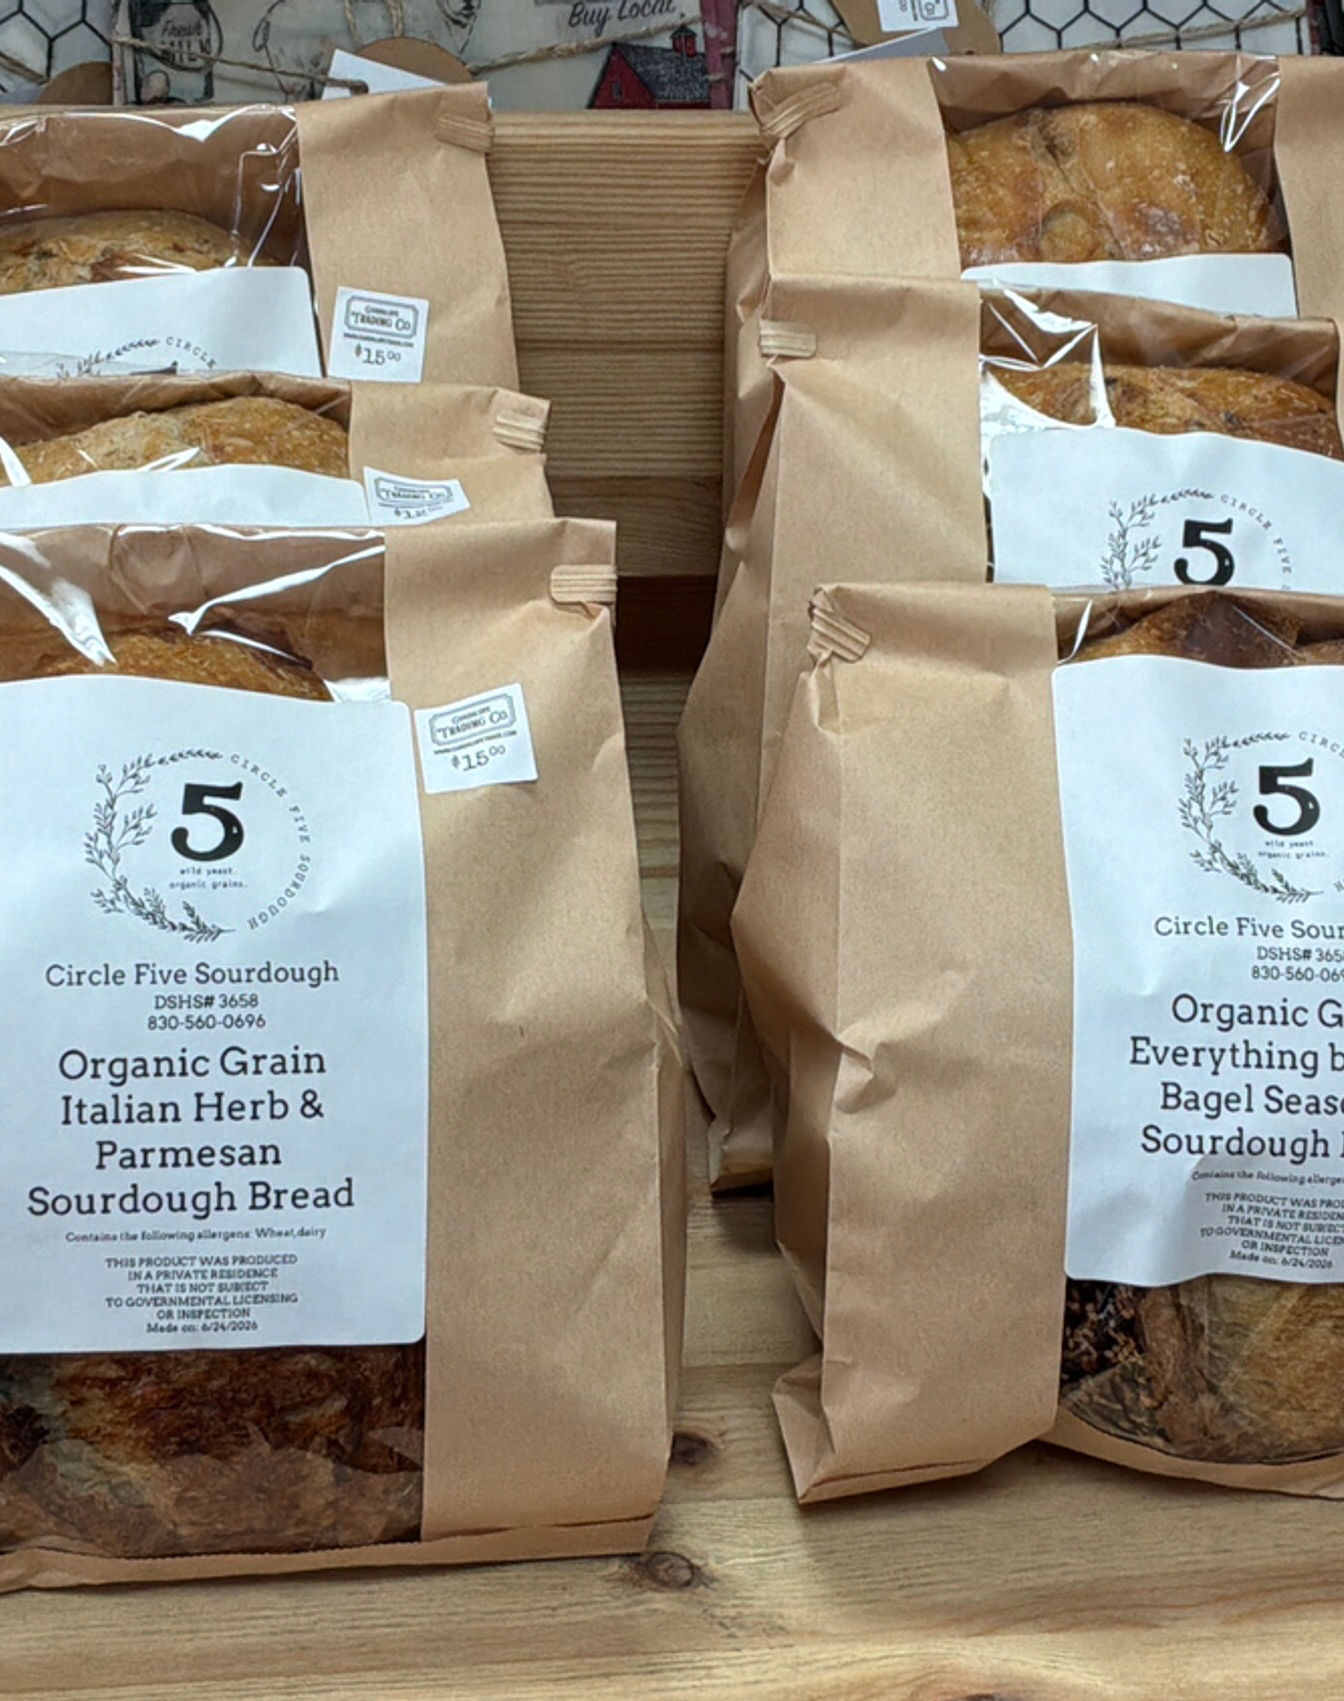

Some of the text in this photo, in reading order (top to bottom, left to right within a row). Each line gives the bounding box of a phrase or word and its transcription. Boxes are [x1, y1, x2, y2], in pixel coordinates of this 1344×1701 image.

[568, 2, 609, 38] Buy
[166, 336, 216, 369] CIRCLE
[1221, 494, 1291, 574] CIRCLE FIVE
[1174, 518, 1235, 586] 5
[1253, 757, 1321, 837] 5
[171, 781, 244, 862] 5
[230, 754, 311, 930] CIRCLE FIVE SOURDOUGH
[1155, 916, 1229, 936] Circle
[1236, 917, 1284, 939] Five
[1257, 947, 1311, 962] DSHS#
[45, 961, 339, 988] Circle Five Sourdough
[155, 994, 258, 1010] DSHS# 3658
[1172, 993, 1308, 1032] Organic
[148, 1014, 266, 1030] 830-560-0696
[59, 1045, 326, 1087] Organic Grain
[1130, 1036, 1319, 1078] Everything
[62, 1089, 324, 1125] Italian Herb &
[1161, 1082, 1254, 1119] Bagel
[96, 1141, 281, 1170] Parmesan
[1141, 1124, 1330, 1165] Sourdough
[28, 1177, 354, 1221] Sourdough Bread
[65, 1232, 117, 1242] Contains
[119, 1232, 138, 1241] the
[141, 1231, 195, 1242] following
[105, 1254, 298, 1268] THIS PRODUCT WAS PRODUCED
[128, 1268, 278, 1281] IN A PRIVATE RESIDENCE
[105, 1293, 298, 1308] TO GOVERNMENTAL LICENSING
[137, 1281, 269, 1294] THAT IS NOT SUBJECT
[147, 1323, 178, 1333] Made
[156, 1308, 250, 1320] OR INSPECTION
